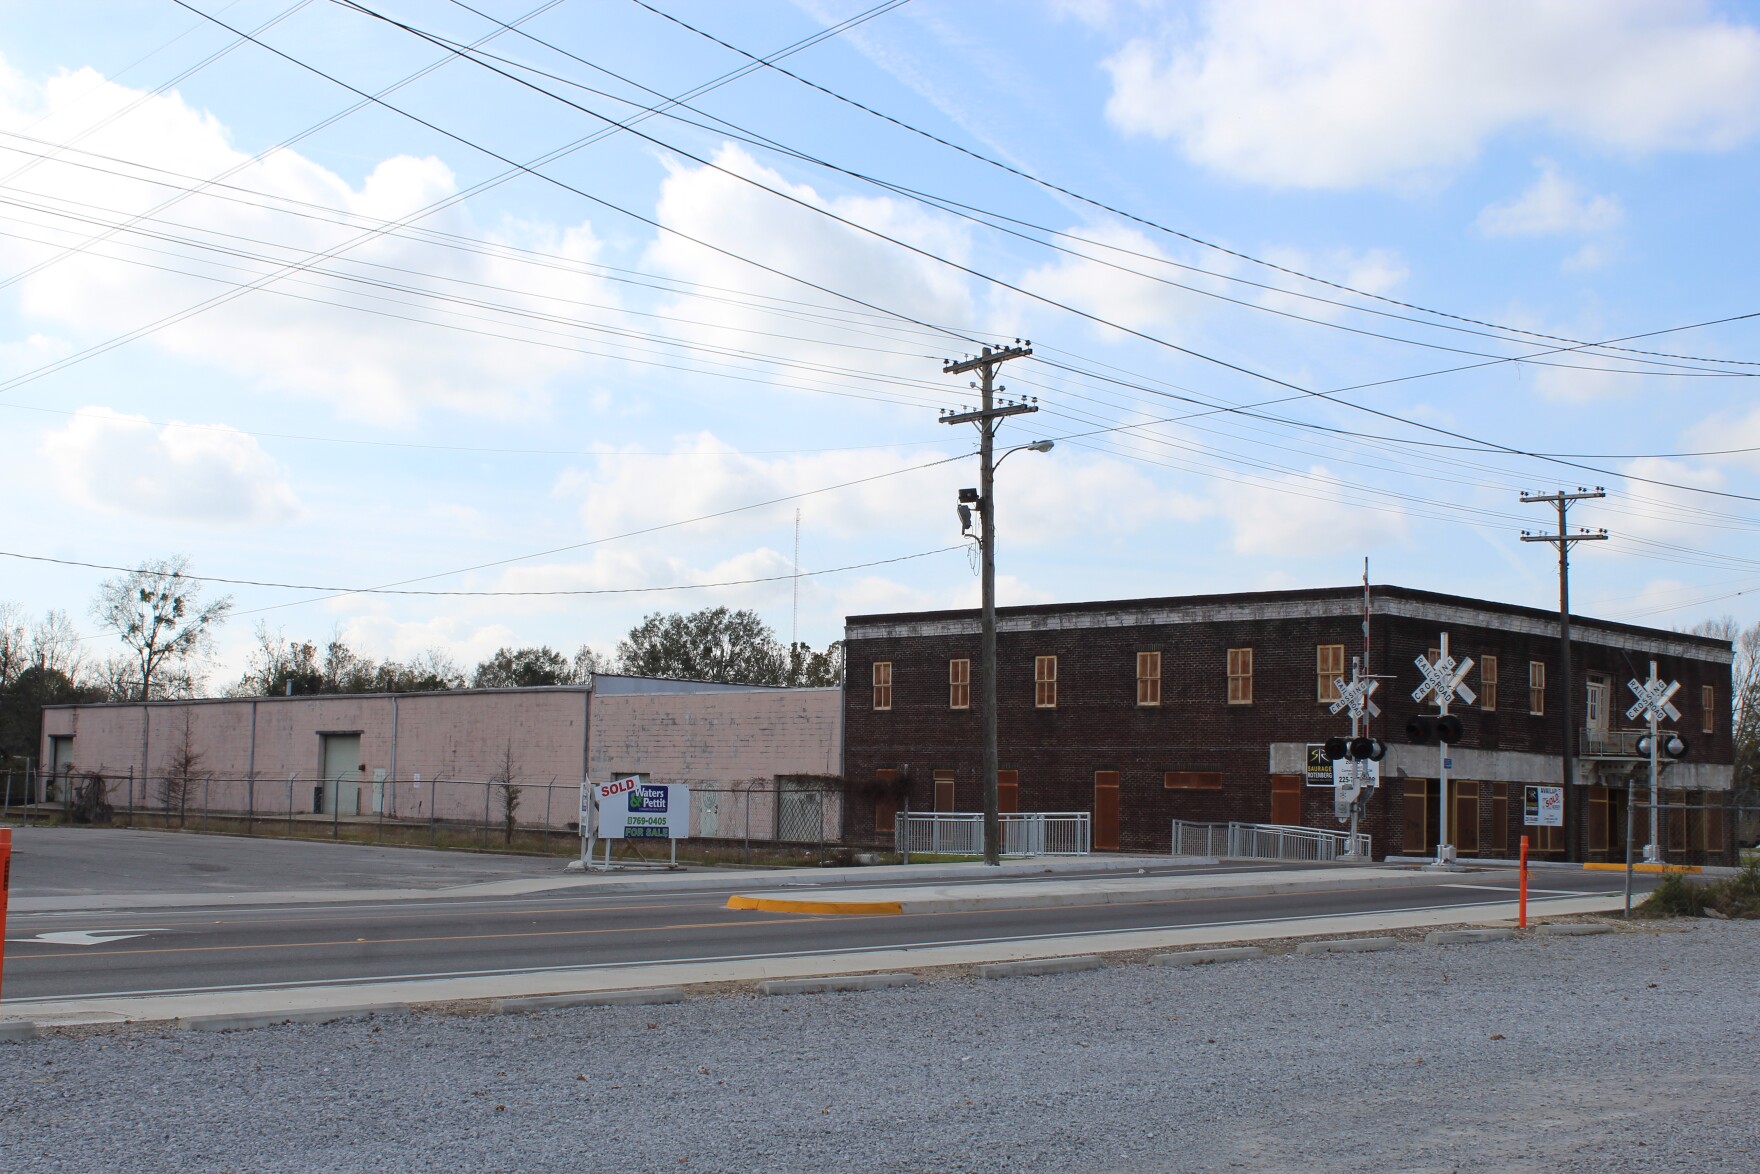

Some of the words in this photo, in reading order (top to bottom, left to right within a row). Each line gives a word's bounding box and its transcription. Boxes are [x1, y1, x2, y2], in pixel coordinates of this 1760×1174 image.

[1416, 657, 1432, 678] RAIL
[1335, 678, 1348, 696] RAIL
[1414, 659, 1454, 700] CROSSING
[1331, 683, 1366, 713] CROSSING
[1434, 681, 1452, 702] ROAD
[1629, 680, 1645, 699] RAIL
[1349, 699, 1362, 717] ROAD
[1628, 682, 1665, 718] CROSSING
[1648, 701, 1664, 719] ROAD
[601, 779, 634, 797] SOLD
[635, 787, 664, 798] Waters
[630, 792, 643, 808] &
[643, 797, 666, 808] Pettit
[632, 816, 667, 825] 769-0405
[625, 827, 644, 837] FOR
[645, 827, 669, 837] SALE
